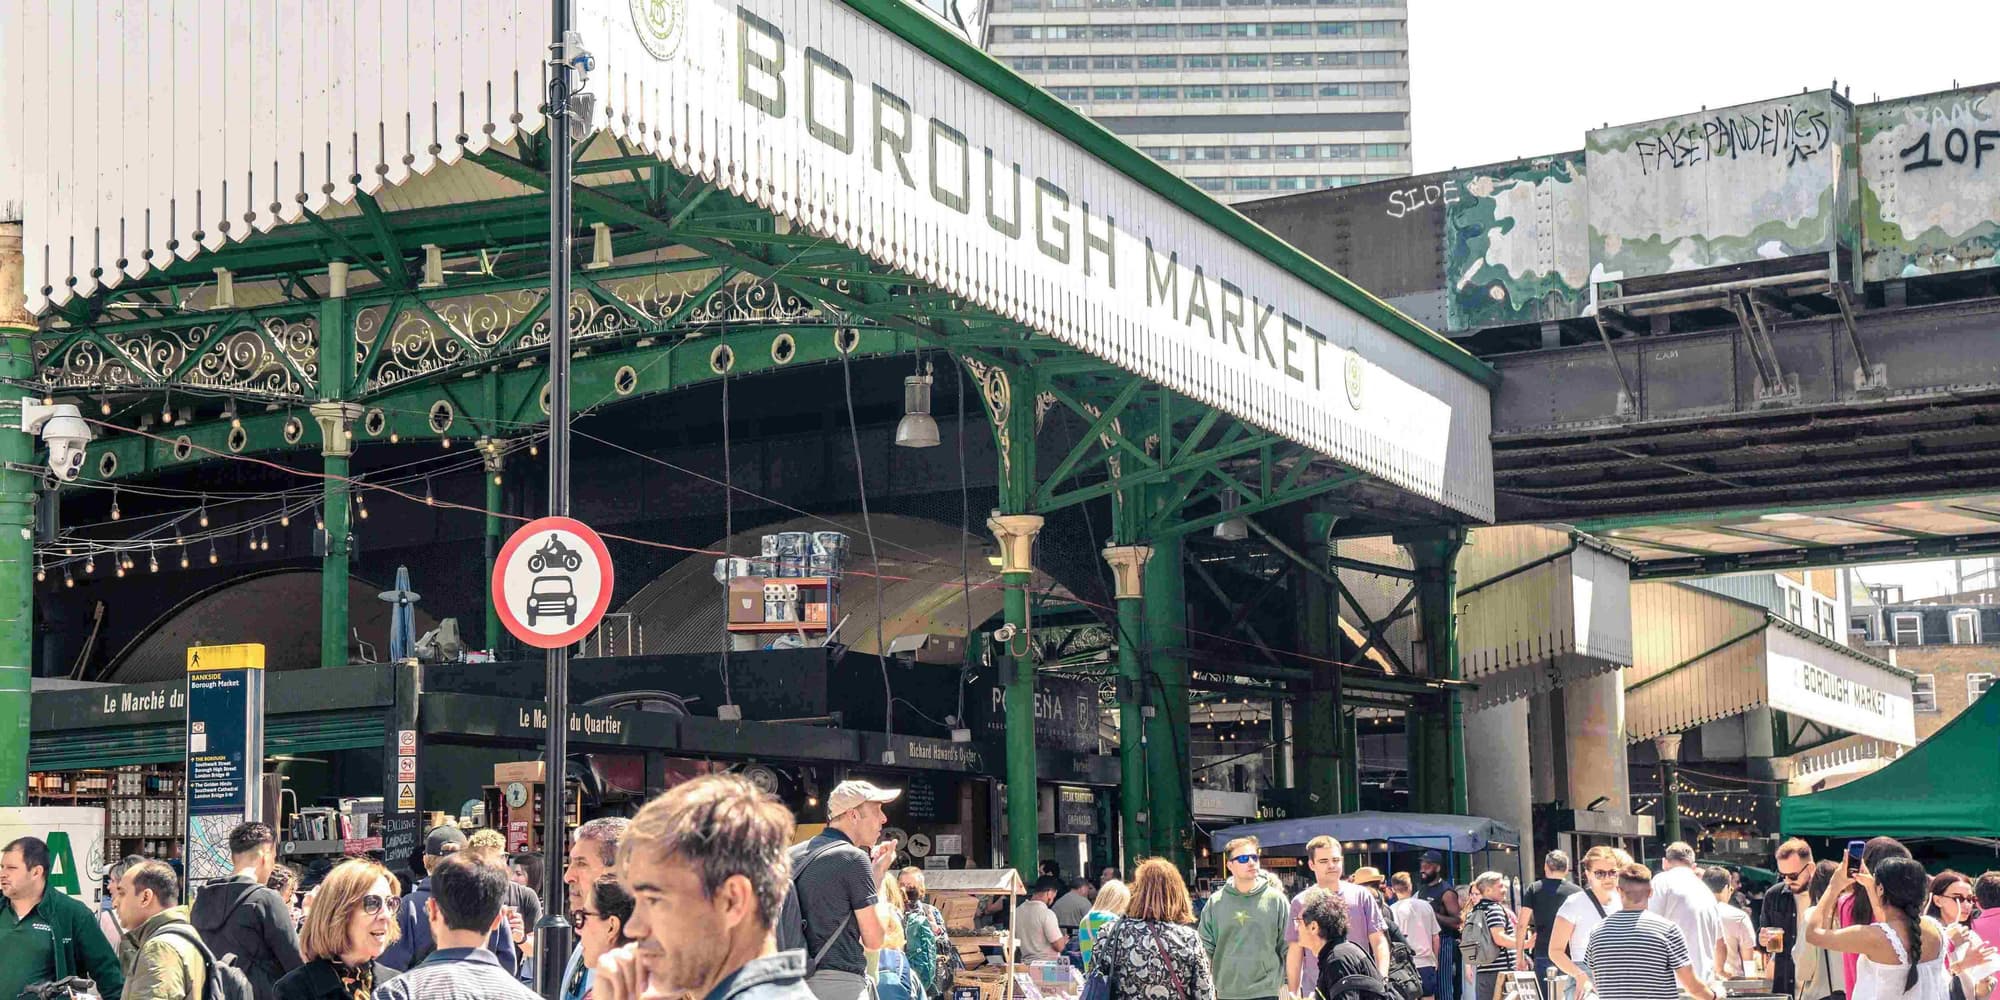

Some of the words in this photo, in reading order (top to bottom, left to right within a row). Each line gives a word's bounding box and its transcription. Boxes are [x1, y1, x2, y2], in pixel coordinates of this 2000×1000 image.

[737, 6, 1116, 290] BOROUGH
[1145, 236, 1327, 391] MARKET
[1386, 180, 1460, 218] SIDE
[191, 673, 222, 681] BANKSIDE
[191, 681, 217, 689] Borough
[218, 679, 240, 687] Market
[1803, 664, 1850, 705] BOROUGH
[1853, 683, 1886, 717] MARKET
[103, 694, 117, 714] Le
[121, 689, 165, 712] Marché
[169, 688, 184, 708] du
[992, 687, 1064, 721] PEÑA
[519, 707, 530, 728] Le
[570, 712, 581, 731] du
[584, 713, 621, 735] Quartier
[909, 742, 932, 759] Richard
[1263, 807, 1274, 818] Oil
[1276, 807, 1286, 818] Co
[46, 831, 82, 896] A
